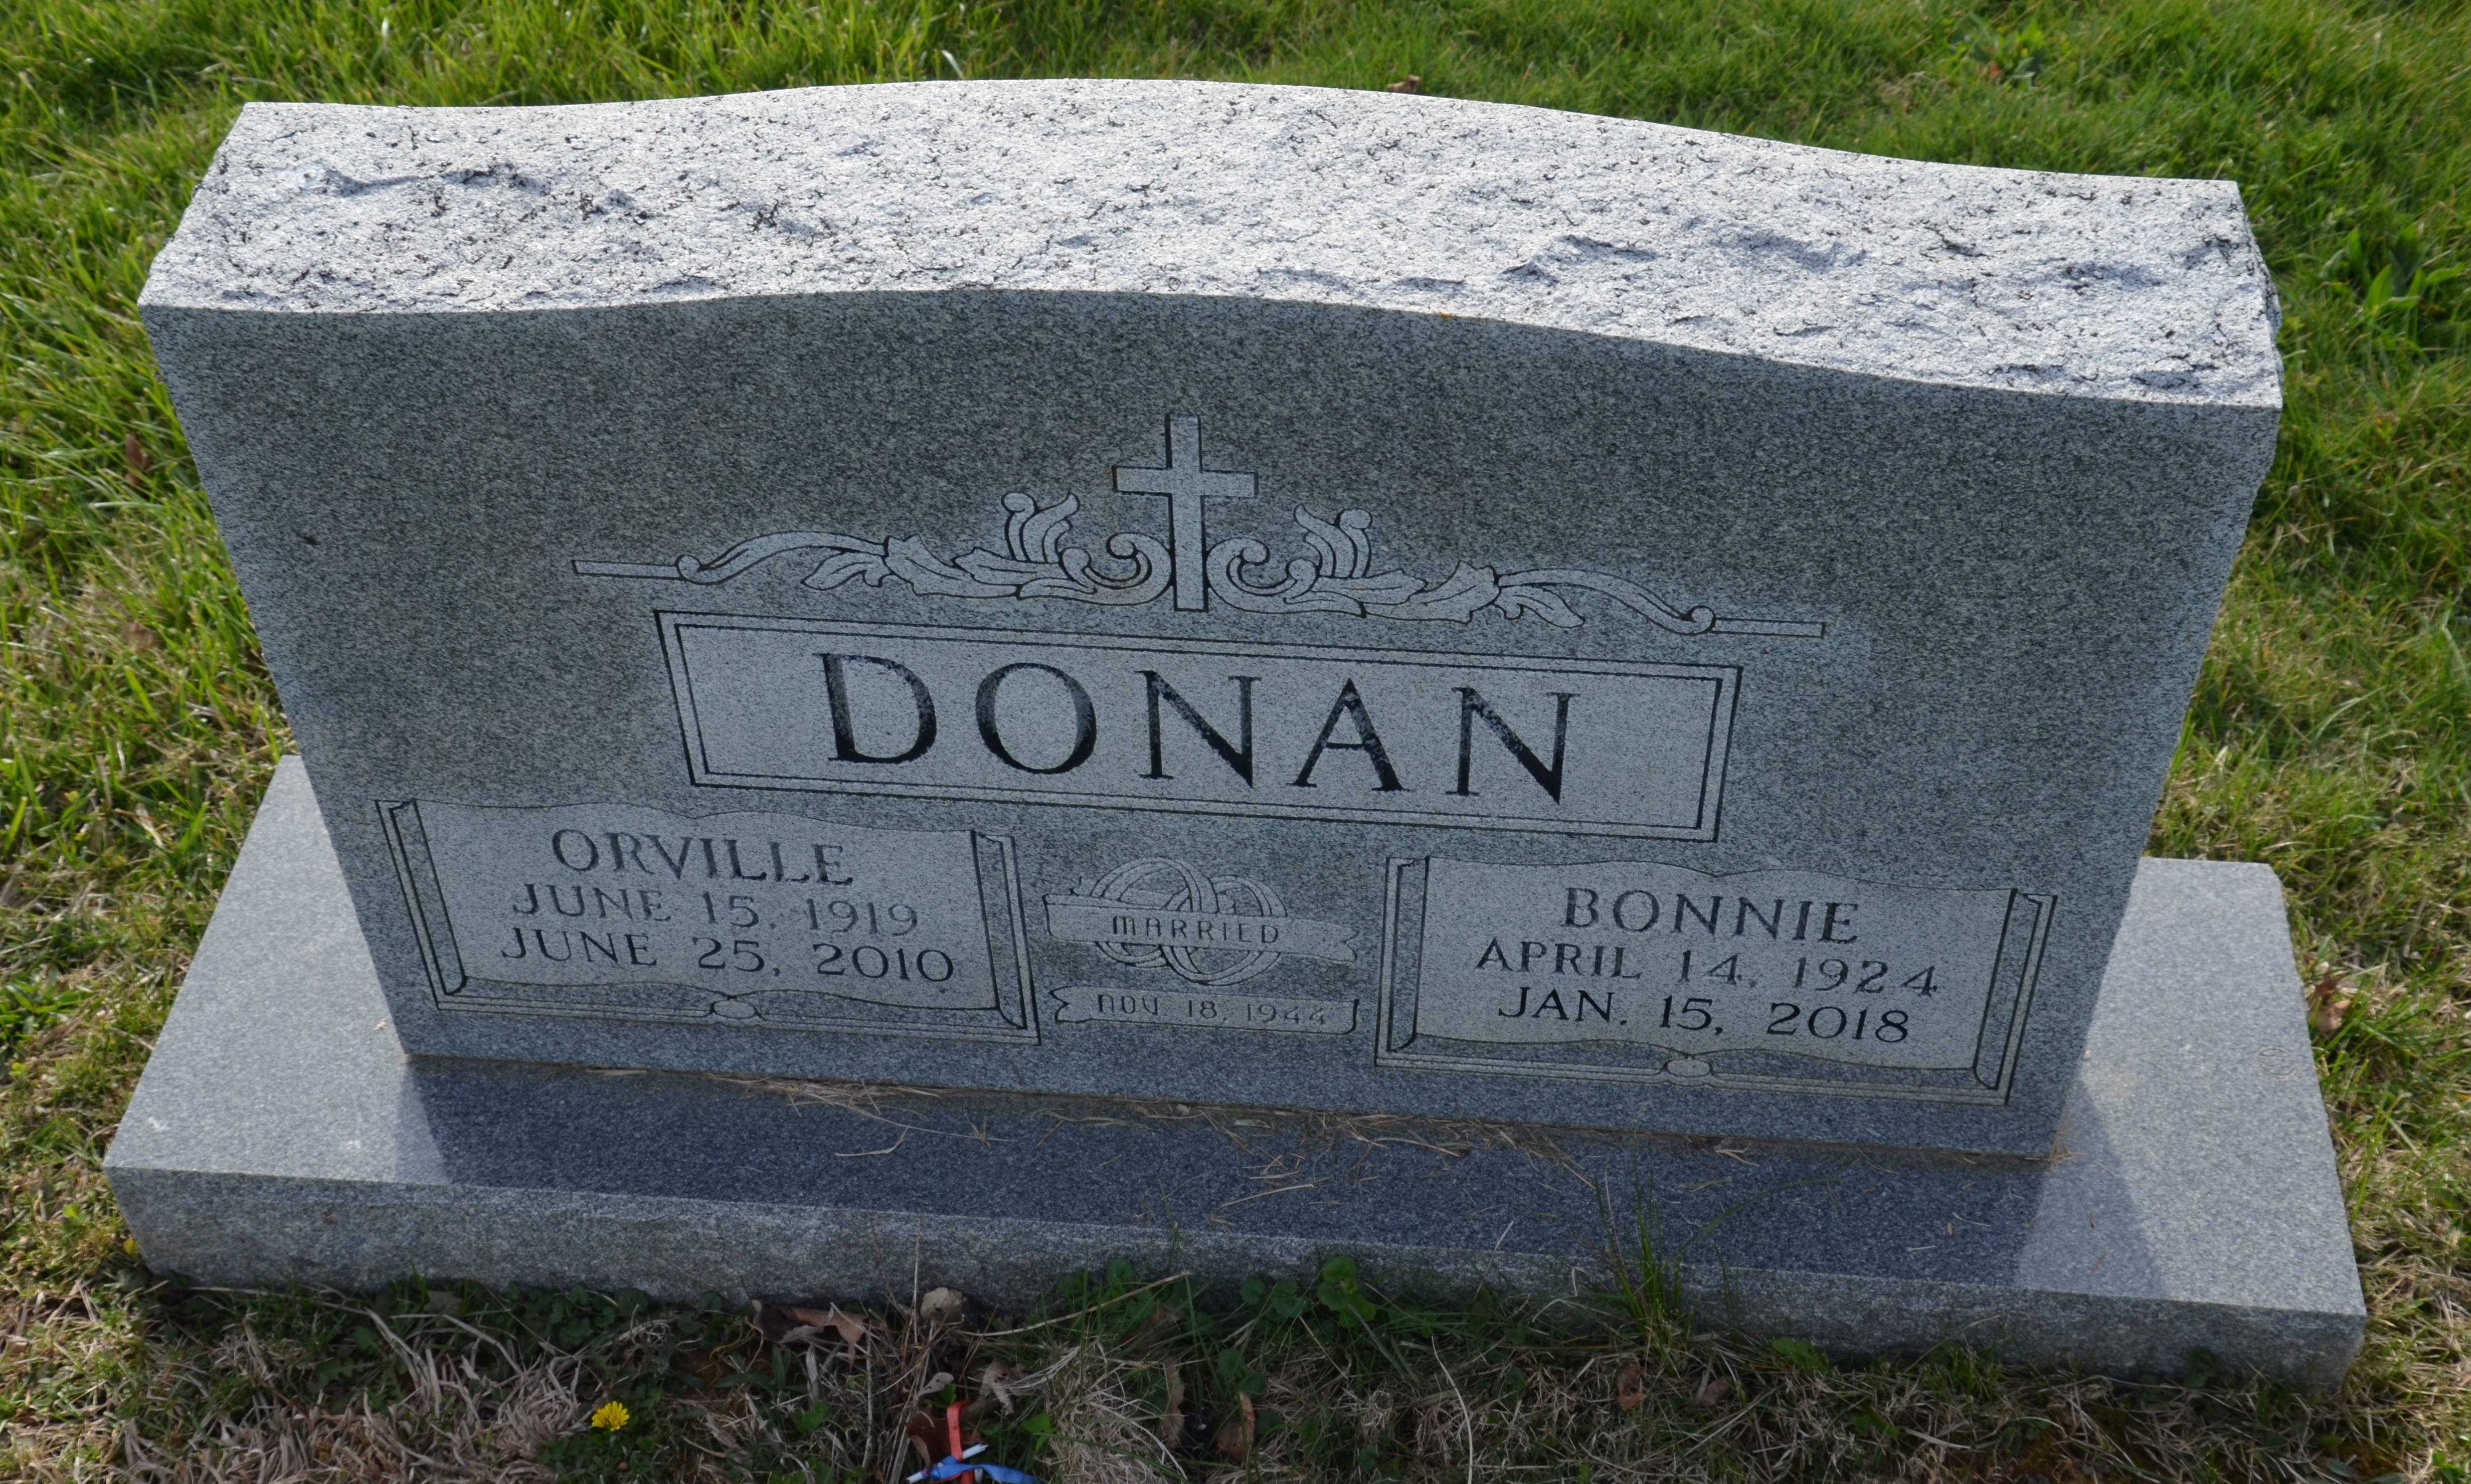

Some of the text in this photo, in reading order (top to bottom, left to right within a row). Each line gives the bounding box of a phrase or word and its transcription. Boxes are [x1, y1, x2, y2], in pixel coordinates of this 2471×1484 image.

[812, 651, 1580, 804] DONAN
[551, 828, 853, 886] ORVILLE
[511, 882, 672, 923] JUNE
[807, 897, 919, 937] 1919
[1112, 915, 1279, 944] MARRIED
[1559, 886, 1859, 944] BONNIE
[501, 926, 955, 983] JUNE 25, 2010
[1474, 937, 1642, 980] APRIL
[1793, 956, 1939, 997] 1924
[1096, 993, 1326, 1025] NOV 18, 1944
[1497, 986, 1910, 1044] JAN. 15, 2018
